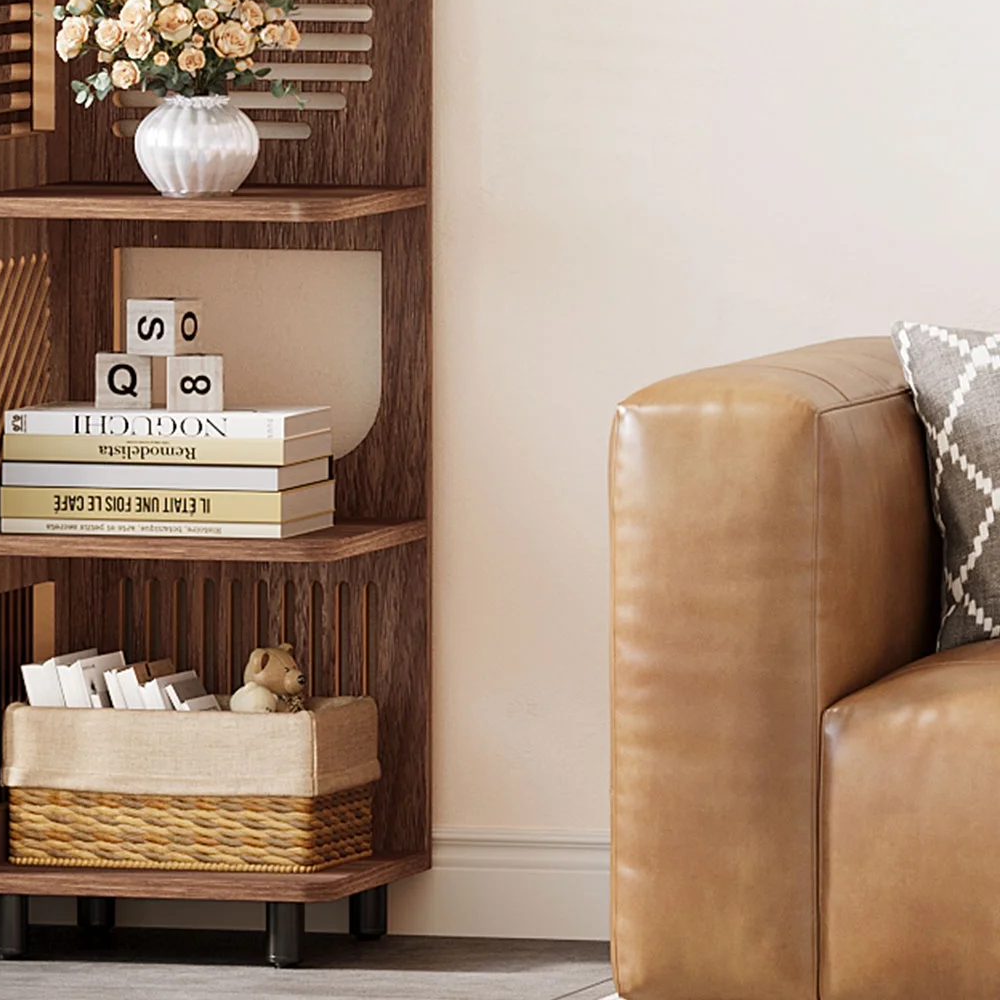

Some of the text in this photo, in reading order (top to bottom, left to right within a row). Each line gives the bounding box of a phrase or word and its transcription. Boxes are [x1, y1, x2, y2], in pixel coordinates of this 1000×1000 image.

[137, 315, 164, 341] S
[107, 364, 138, 397] Q
[180, 375, 211, 395] 8
[74, 415, 228, 437] NOGUCHI
[99, 444, 197, 461] Remodelista
[53, 495, 211, 516] IL ÉTAIT UNE FOIS LE CAFÉ
